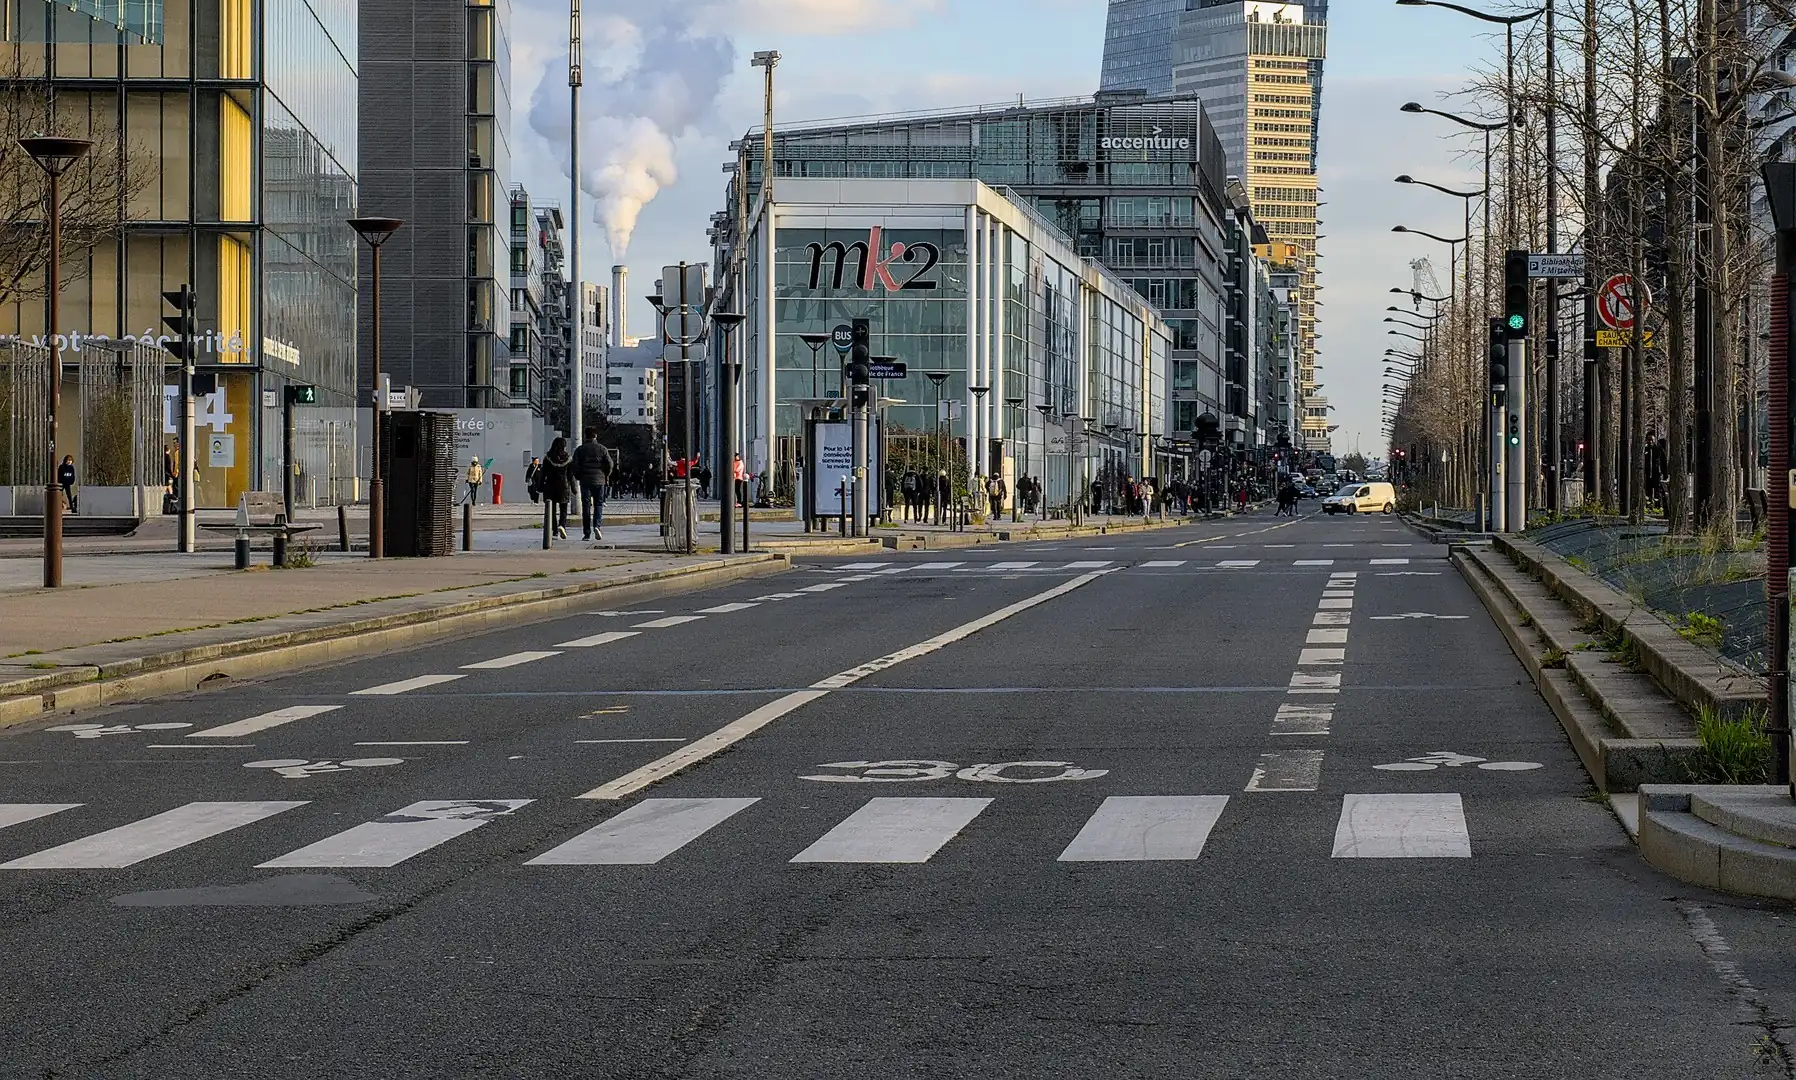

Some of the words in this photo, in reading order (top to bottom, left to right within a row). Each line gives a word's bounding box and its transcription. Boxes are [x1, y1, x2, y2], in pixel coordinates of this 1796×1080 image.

[1101, 134, 1189, 149] accenture
[803, 225, 940, 291] mk2
[835, 331, 852, 340] BUS
[1602, 331, 1620, 339] SAU
[123, 327, 251, 359] écrité,
[456, 417, 485, 430] trée
